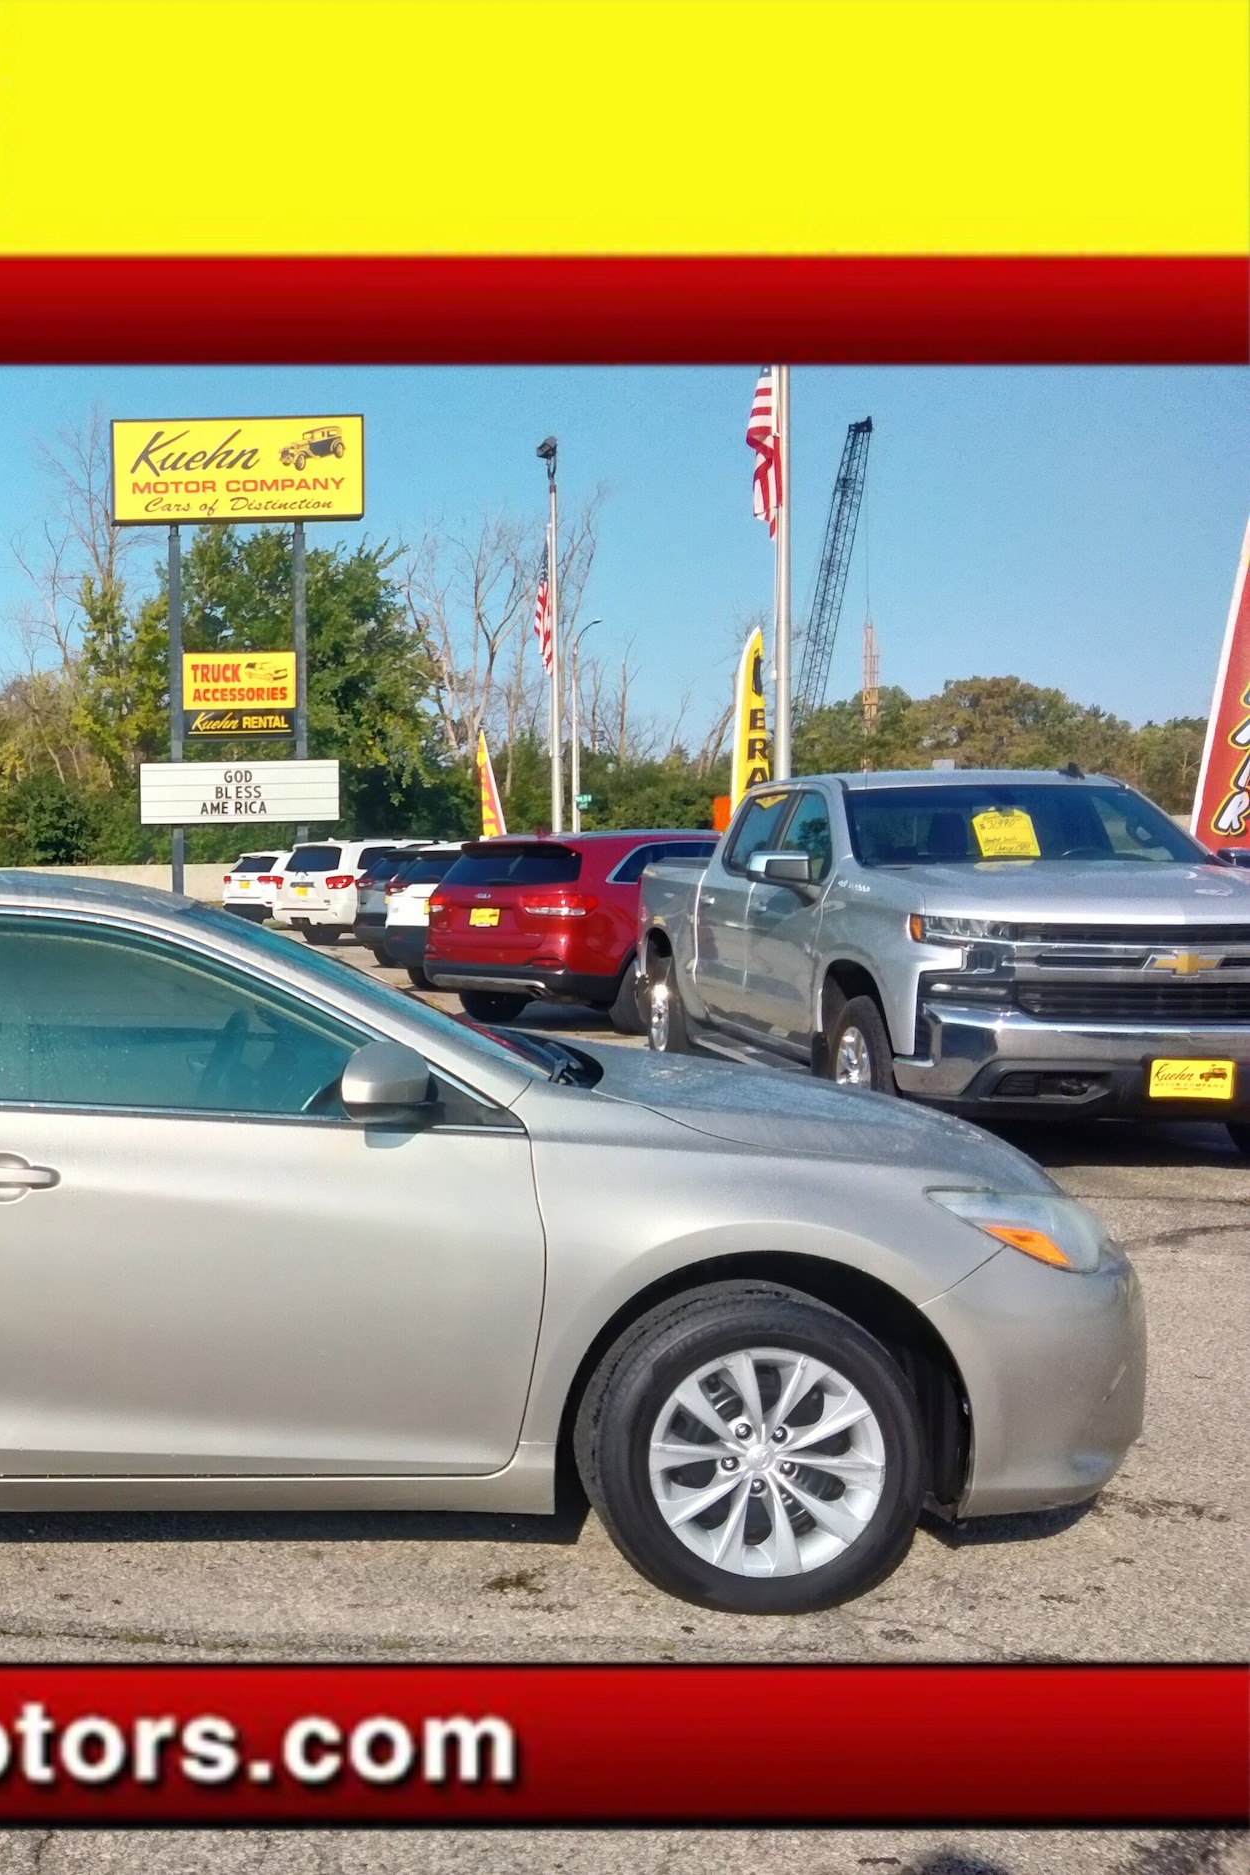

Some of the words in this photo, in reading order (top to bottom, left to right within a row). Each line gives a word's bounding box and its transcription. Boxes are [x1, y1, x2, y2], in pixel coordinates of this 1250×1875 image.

[130, 428, 260, 477] Kuehn
[132, 480, 217, 494] MOTOR
[225, 477, 345, 493] COMPANY
[144, 497, 192, 513] Cars
[199, 499, 220, 517] of
[230, 496, 334, 512] Distinction
[191, 663, 241, 683] TRUCK
[192, 686, 287, 702] ACCESSORIES
[191, 711, 240, 732] Kuehn
[242, 715, 289, 730] RENTAL
[223, 770, 253, 784] GOD
[215, 785, 262, 800] BLESS
[1153, 1063, 1194, 1082] Kuehn
